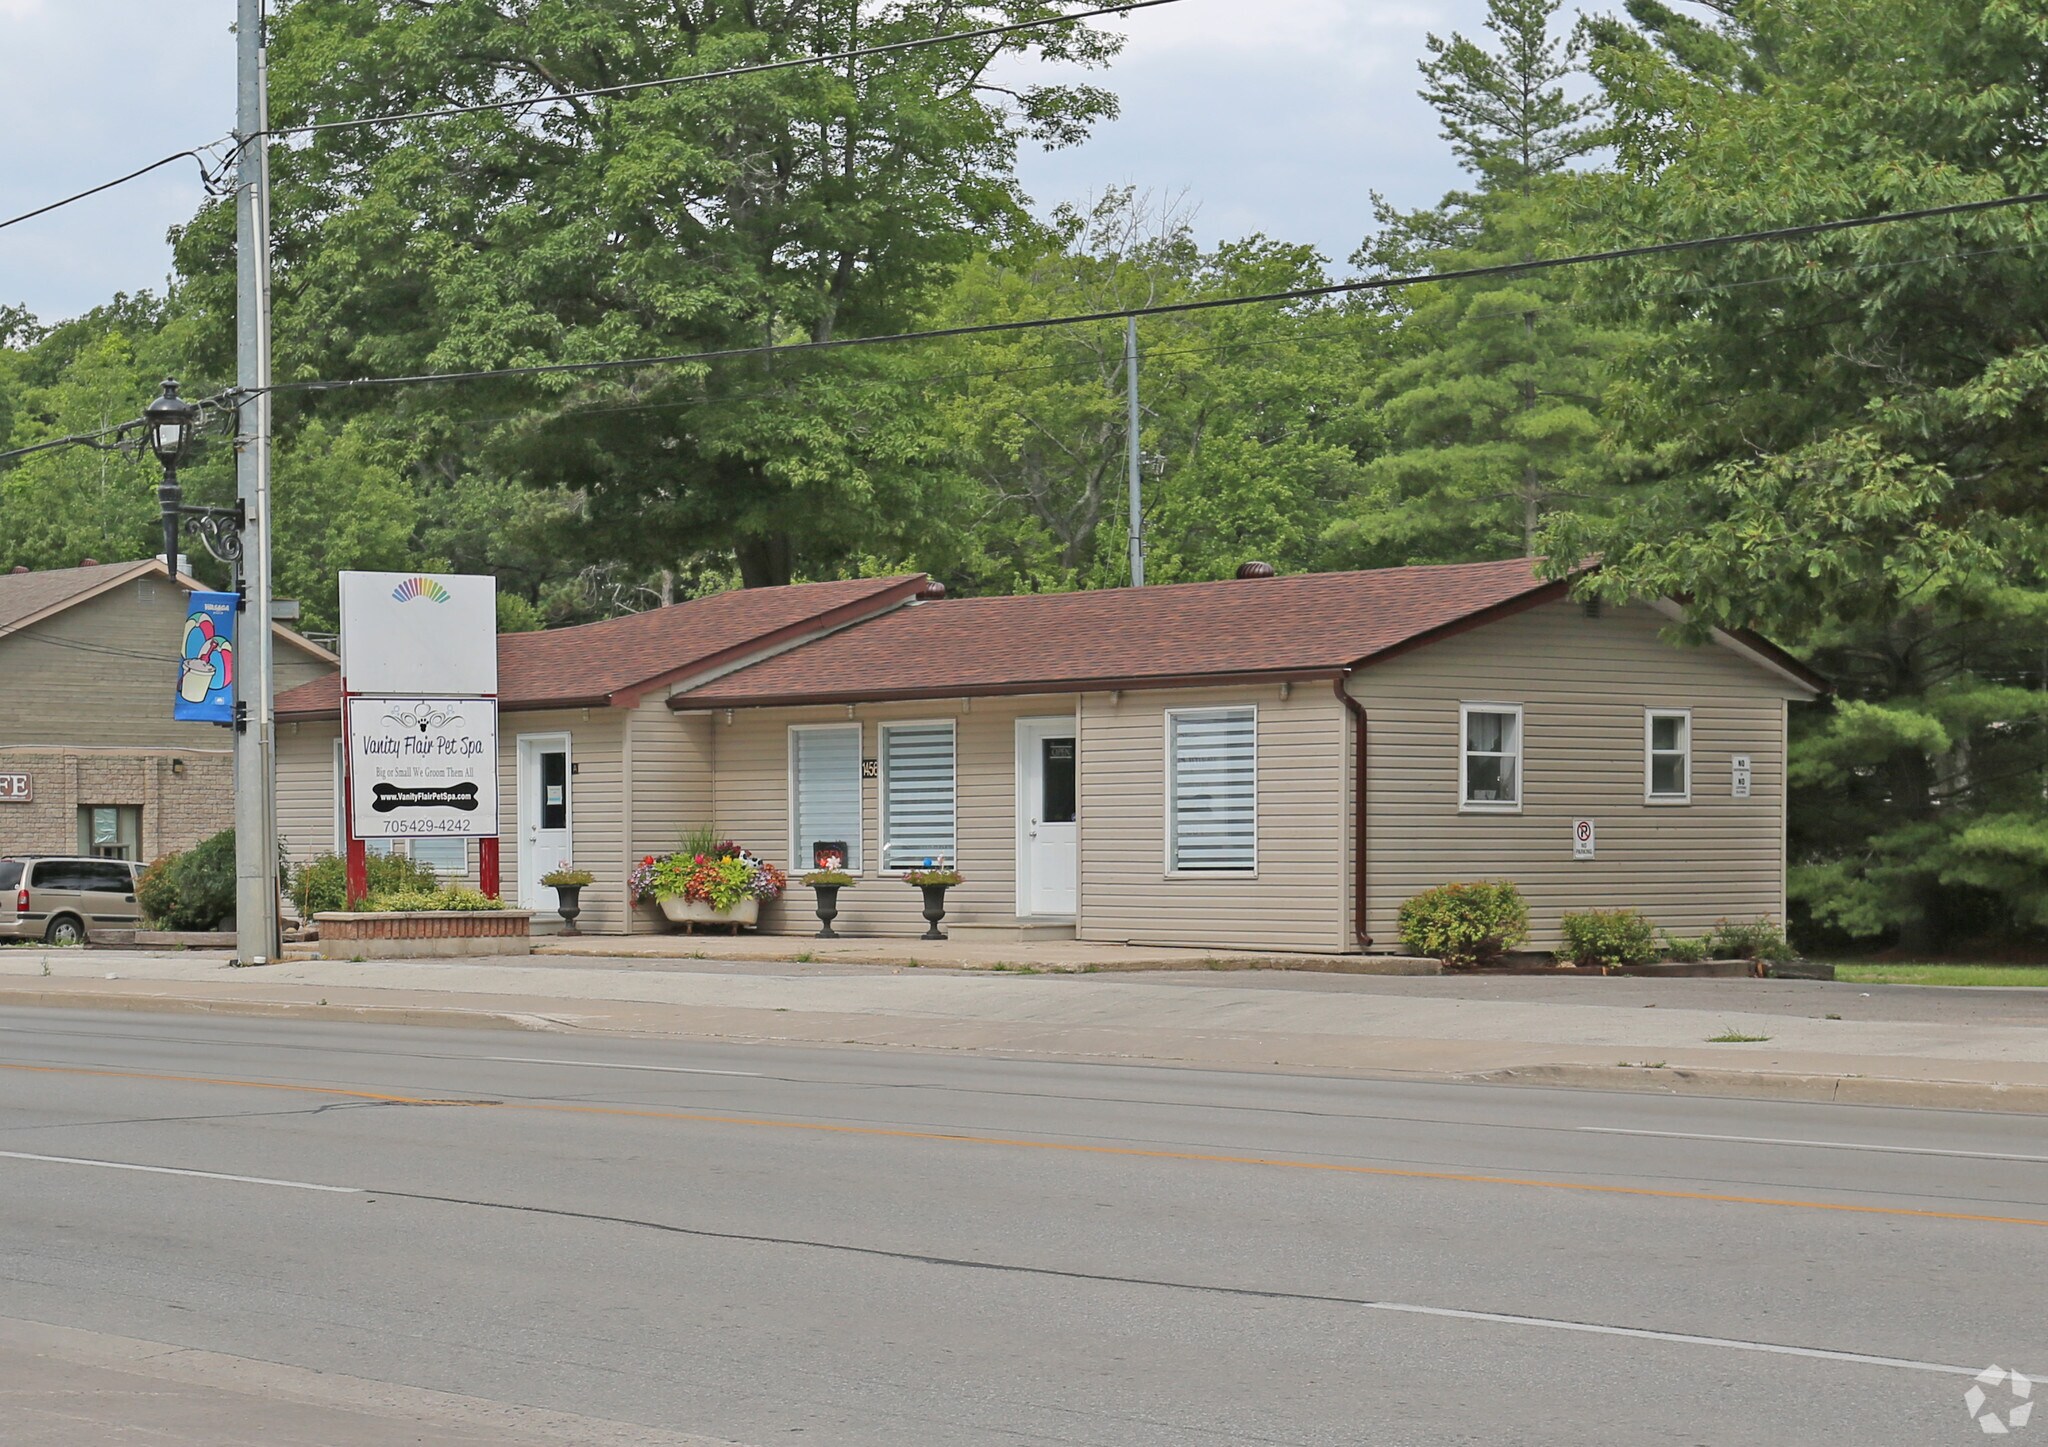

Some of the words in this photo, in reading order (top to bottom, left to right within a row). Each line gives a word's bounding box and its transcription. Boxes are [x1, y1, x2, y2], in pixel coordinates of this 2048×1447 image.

[363, 735, 400, 759] Vanity
[404, 735, 434, 755] Flair
[436, 735, 458, 755] Pet
[460, 736, 484, 759] Spa
[376, 766, 386, 780] Big
[387, 768, 394, 778] or
[395, 766, 412, 778] Small
[413, 766, 423, 778] We
[425, 766, 445, 778] Groom
[447, 766, 463, 778] Them
[465, 766, 474, 778] All
[380, 792, 472, 802] www.VanityFlairPetSpa.com
